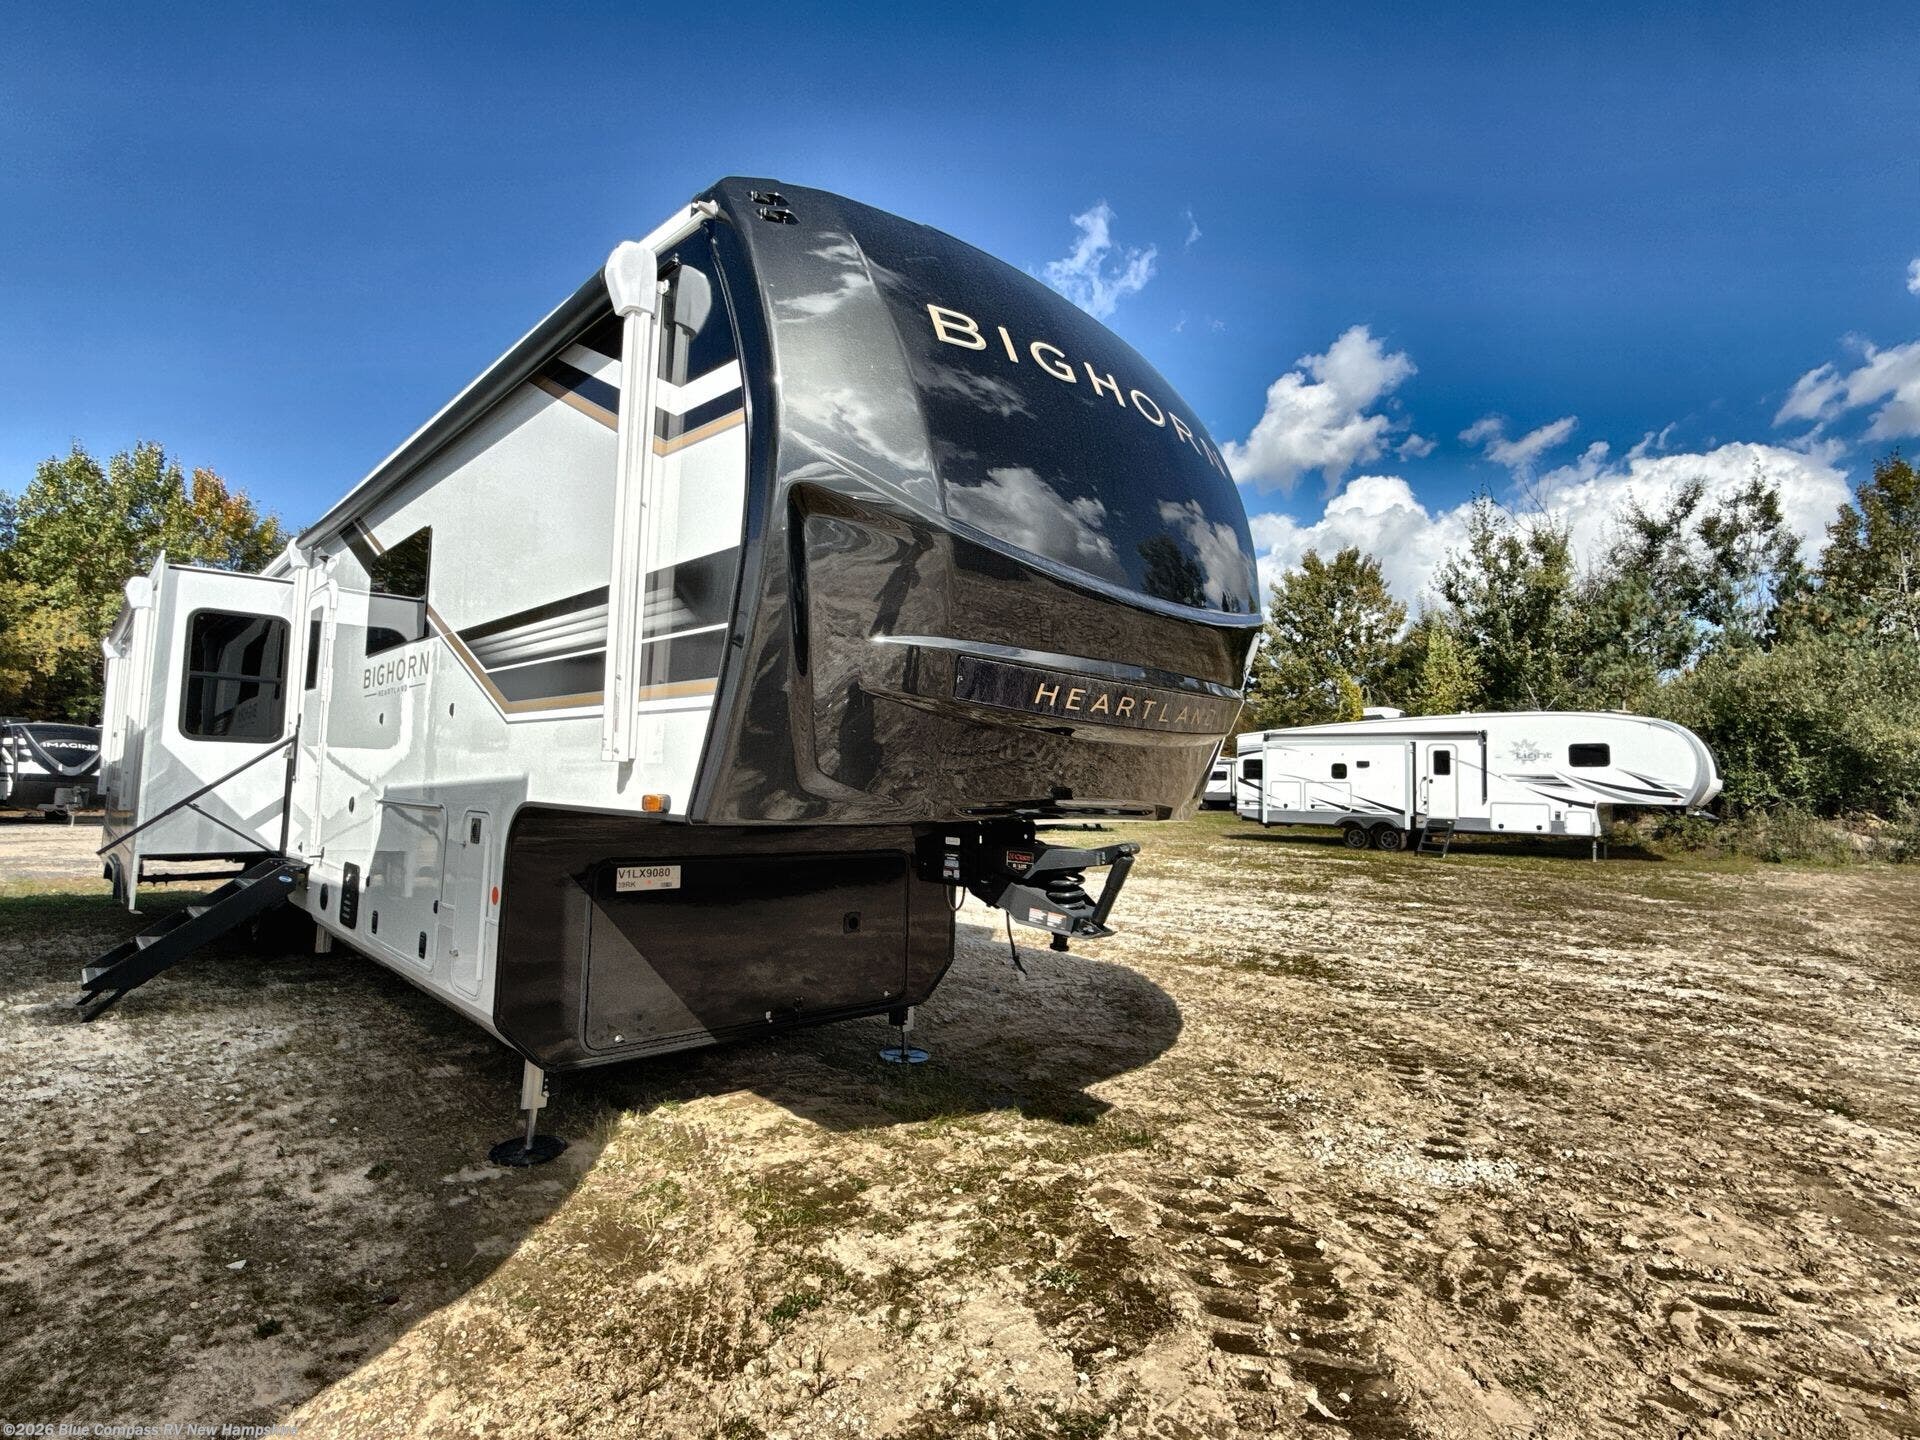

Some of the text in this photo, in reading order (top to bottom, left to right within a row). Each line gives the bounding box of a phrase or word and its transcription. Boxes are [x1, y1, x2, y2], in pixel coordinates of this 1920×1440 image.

[927, 303, 1227, 477] BIGHORN
[363, 651, 429, 689] BIGHORN
[1034, 683, 1217, 728] HEARTLAND
[42, 742, 99, 751] IMAGINE
[618, 867, 671, 879] V1LX9080
